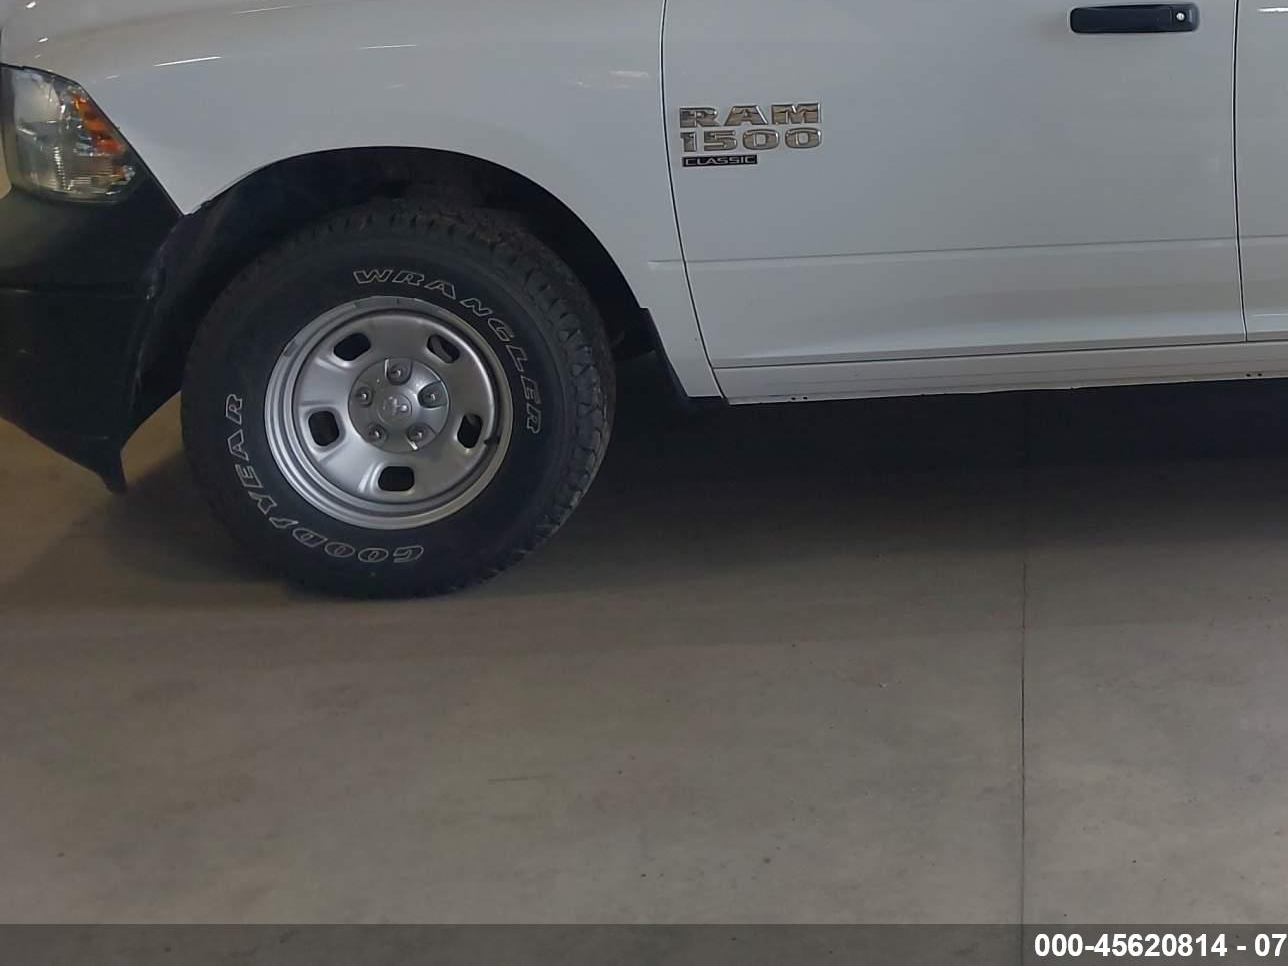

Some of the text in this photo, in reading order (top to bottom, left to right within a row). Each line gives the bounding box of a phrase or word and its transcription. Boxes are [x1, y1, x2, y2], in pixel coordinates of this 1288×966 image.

[679, 102, 822, 129] RAM
[680, 127, 823, 153] 1500
[684, 155, 757, 166] CLASSIC
[353, 268, 545, 434] WRANGLER
[225, 393, 425, 564] GOODYEAR
